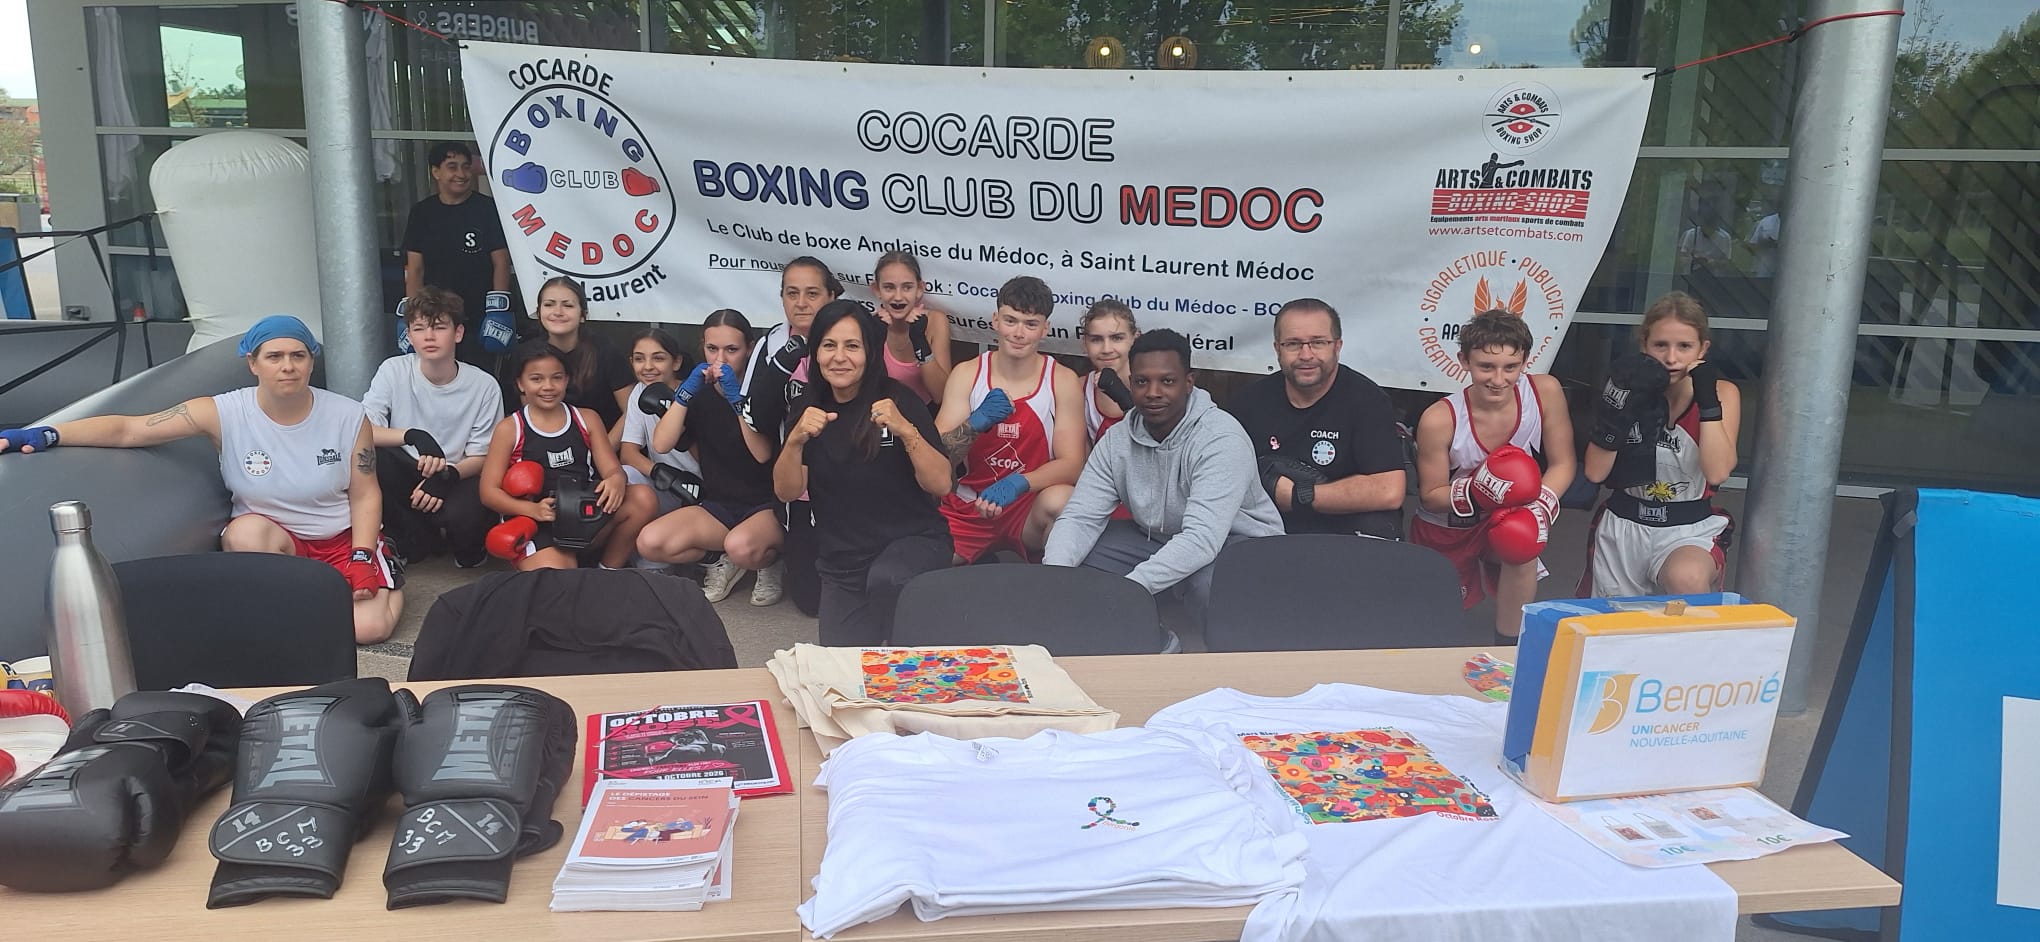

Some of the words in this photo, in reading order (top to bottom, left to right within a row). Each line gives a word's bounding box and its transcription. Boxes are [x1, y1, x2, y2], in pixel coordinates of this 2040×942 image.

[509, 59, 613, 96] COCARDE
[1497, 97, 1514, 114] ARTS
[1522, 92, 1549, 114] COMBATS
[504, 95, 645, 163] BOXING
[857, 110, 1115, 162] COCARDE
[1496, 126, 1521, 145] BOXING
[1524, 127, 1542, 144] SHOP
[550, 170, 619, 189] CLUB
[1435, 169, 1481, 189] ARTS
[1494, 176, 1504, 189] &
[1505, 169, 1593, 190] COMBATS
[693, 160, 869, 210] BOXING
[882, 173, 1015, 219] CLUB
[1029, 181, 1103, 224] DU
[1120, 185, 1324, 233] MEDOC
[1448, 192, 1520, 212] BOXING
[1522, 192, 1576, 214] SHOP
[512, 203, 659, 265] MEDOC
[1429, 226, 1584, 243] www.artsetcombats.com
[707, 219, 729, 236] Le
[733, 223, 773, 243] Club
[778, 229, 801, 246] de
[806, 231, 852, 251] boxe
[857, 236, 942, 258] Anglaise
[948, 243, 973, 261] du
[979, 244, 1054, 270] Médoc,
[1061, 250, 1073, 268] à
[1080, 251, 1136, 272] Saint
[1142, 254, 1230, 278] Laurent
[1236, 260, 1315, 281] Médoc
[585, 264, 667, 303] Laurent
[709, 254, 746, 269] Pour
[751, 259, 785, 271] nous
[837, 272, 861, 284] sur
[957, 281, 999, 298] Coca
[1052, 292, 1096, 309] oxing
[1147, 296, 1169, 312] du
[1175, 298, 1237, 314] Médoc
[1254, 303, 1282, 316] BC
[1421, 250, 1508, 313] SIGNALETIQUE
[1518, 256, 1564, 321] PUBLICITE
[947, 313, 994, 330] surés
[1187, 336, 1235, 351] éral
[1310, 430, 1339, 440] COACH
[990, 457, 1020, 470] SCOP
[1635, 671, 1780, 718] Bergonié
[610, 709, 720, 728] OCTOBRE
[1631, 722, 1701, 735] UNICANCER
[258, 696, 340, 789] METAL
[432, 690, 521, 781] METAL
[1630, 729, 1749, 748] NOUVELLE-AQUITAINE
[232, 811, 262, 834] 14
[476, 813, 504, 836] 14
[1659, 845, 1697, 856] 10€
[1756, 834, 1793, 845] 10€
